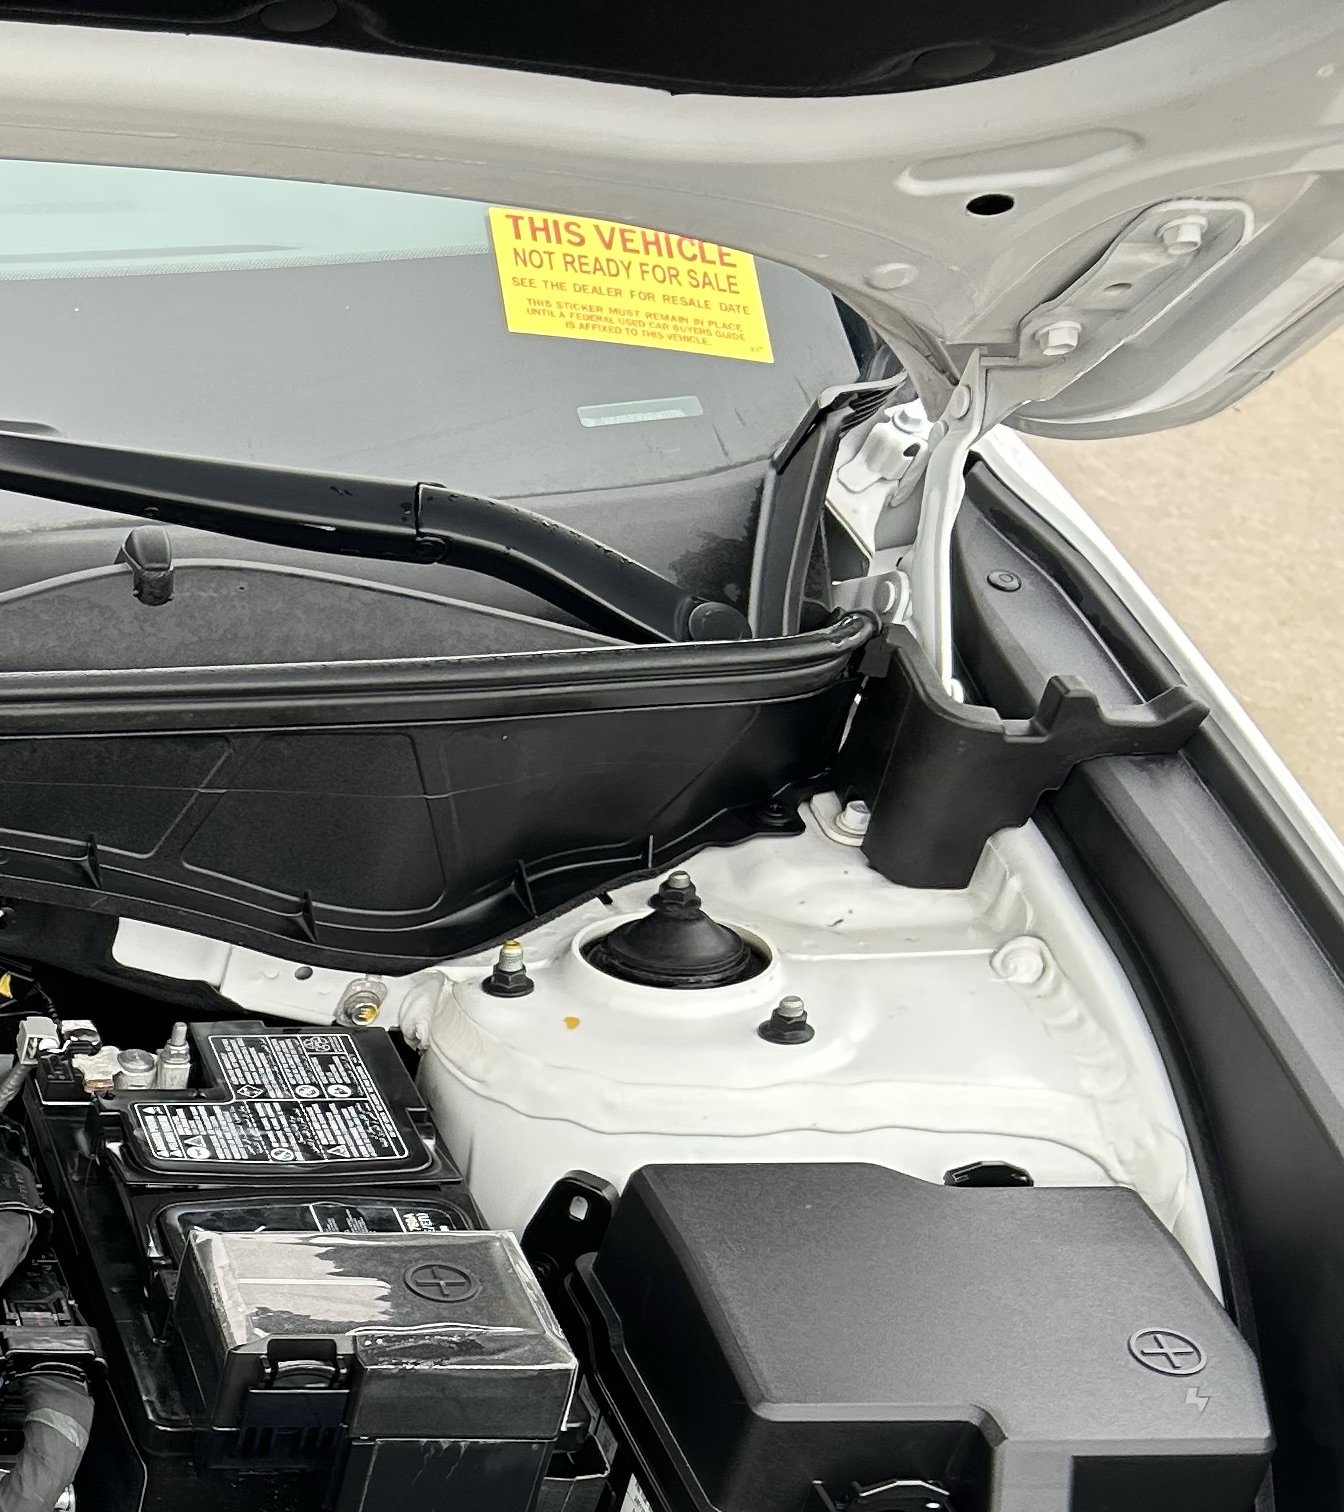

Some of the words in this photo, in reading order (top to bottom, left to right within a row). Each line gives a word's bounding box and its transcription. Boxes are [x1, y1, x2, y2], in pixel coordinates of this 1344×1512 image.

[505, 214, 586, 247] THIS
[593, 223, 737, 268] VEHICLE
[513, 247, 555, 271] NOT
[562, 252, 632, 279] READY
[639, 262, 682, 287] FOR
[687, 268, 740, 294] SALE
[512, 276, 537, 289] SEE
[542, 279, 567, 291] THE
[573, 283, 622, 298] DEALER
[630, 290, 656, 302] FOR
[662, 294, 712, 310] RESALE
[719, 302, 750, 315] DATE
[526, 298, 552, 308] THIS
[556, 301, 603, 313] STICKER
[608, 306, 640, 317] MUST
[645, 312, 689, 324] REMAIN
[693, 317, 704, 326] IN
[707, 319, 743, 332] PLACE
[526, 308, 556, 318] UNTIL
[558, 311, 565, 319] A
[569, 312, 615, 324] FEDERAL
[617, 317, 646, 328] USED
[649, 321, 669, 331] CAR
[672, 325, 713, 337] BUYERS
[714, 330, 746, 342] GUIDE
[565, 321, 576, 329] IS
[578, 322, 622, 334] AFFIXED
[625, 328, 638, 337] TO
[642, 330, 665, 340] THIS
